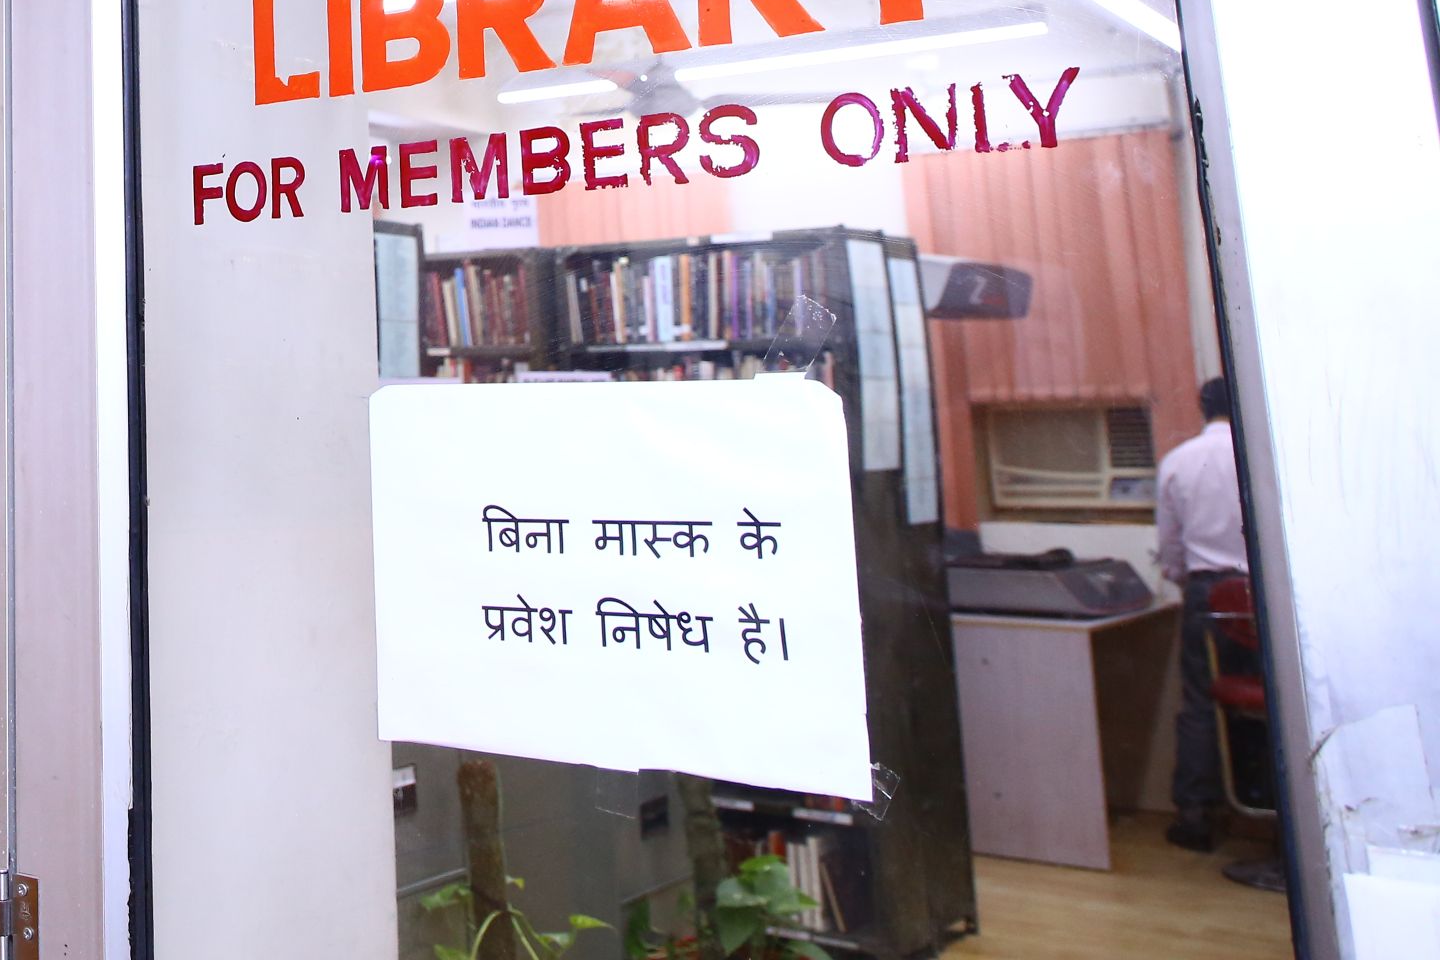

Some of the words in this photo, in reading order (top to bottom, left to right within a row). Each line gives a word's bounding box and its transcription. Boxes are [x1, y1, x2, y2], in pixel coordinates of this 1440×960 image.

[192, 156, 305, 226] FOR
[338, 104, 759, 215] MEMBERS
[820, 67, 1080, 168] ONLY
[482, 504, 569, 554] बिना
[592, 519, 712, 558] मास्क
[737, 507, 781, 559] के
[481, 594, 572, 645] प्रवेश
[595, 597, 713, 653] निषेध
